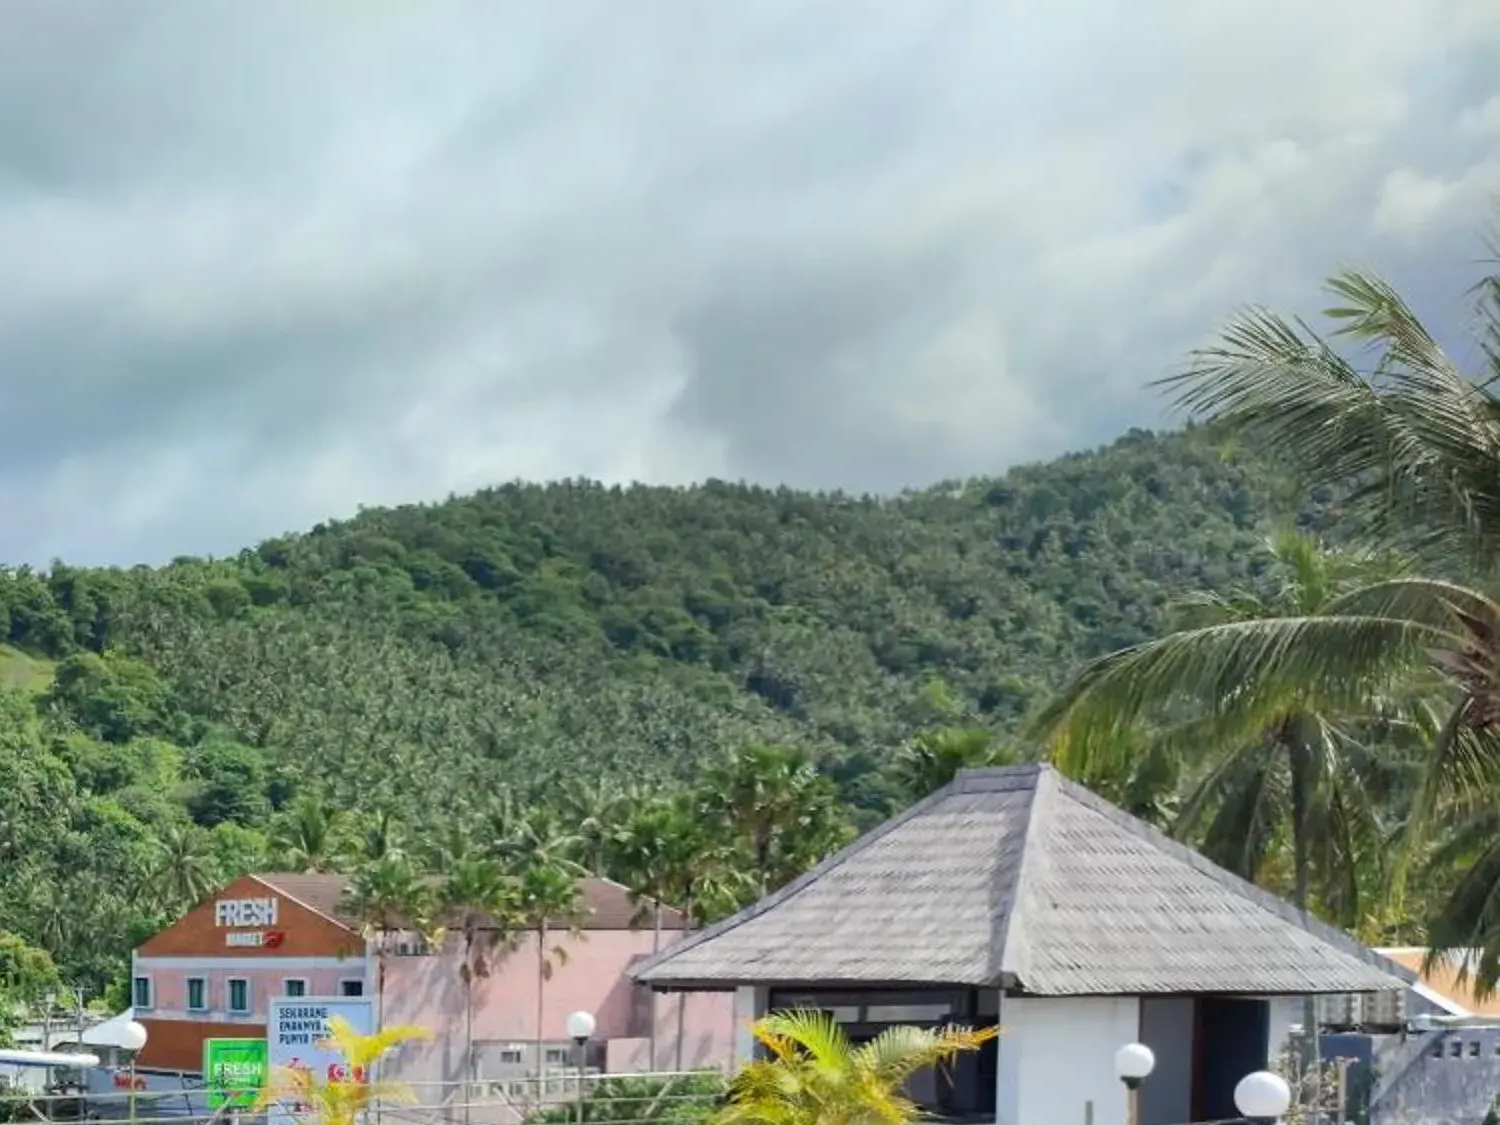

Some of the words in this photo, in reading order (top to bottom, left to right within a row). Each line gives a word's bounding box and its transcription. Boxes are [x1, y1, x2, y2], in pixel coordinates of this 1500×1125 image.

[215, 898, 277, 927] FRESH
[279, 1007, 328, 1019] SEKARANG
[213, 1062, 261, 1076] FRESH
